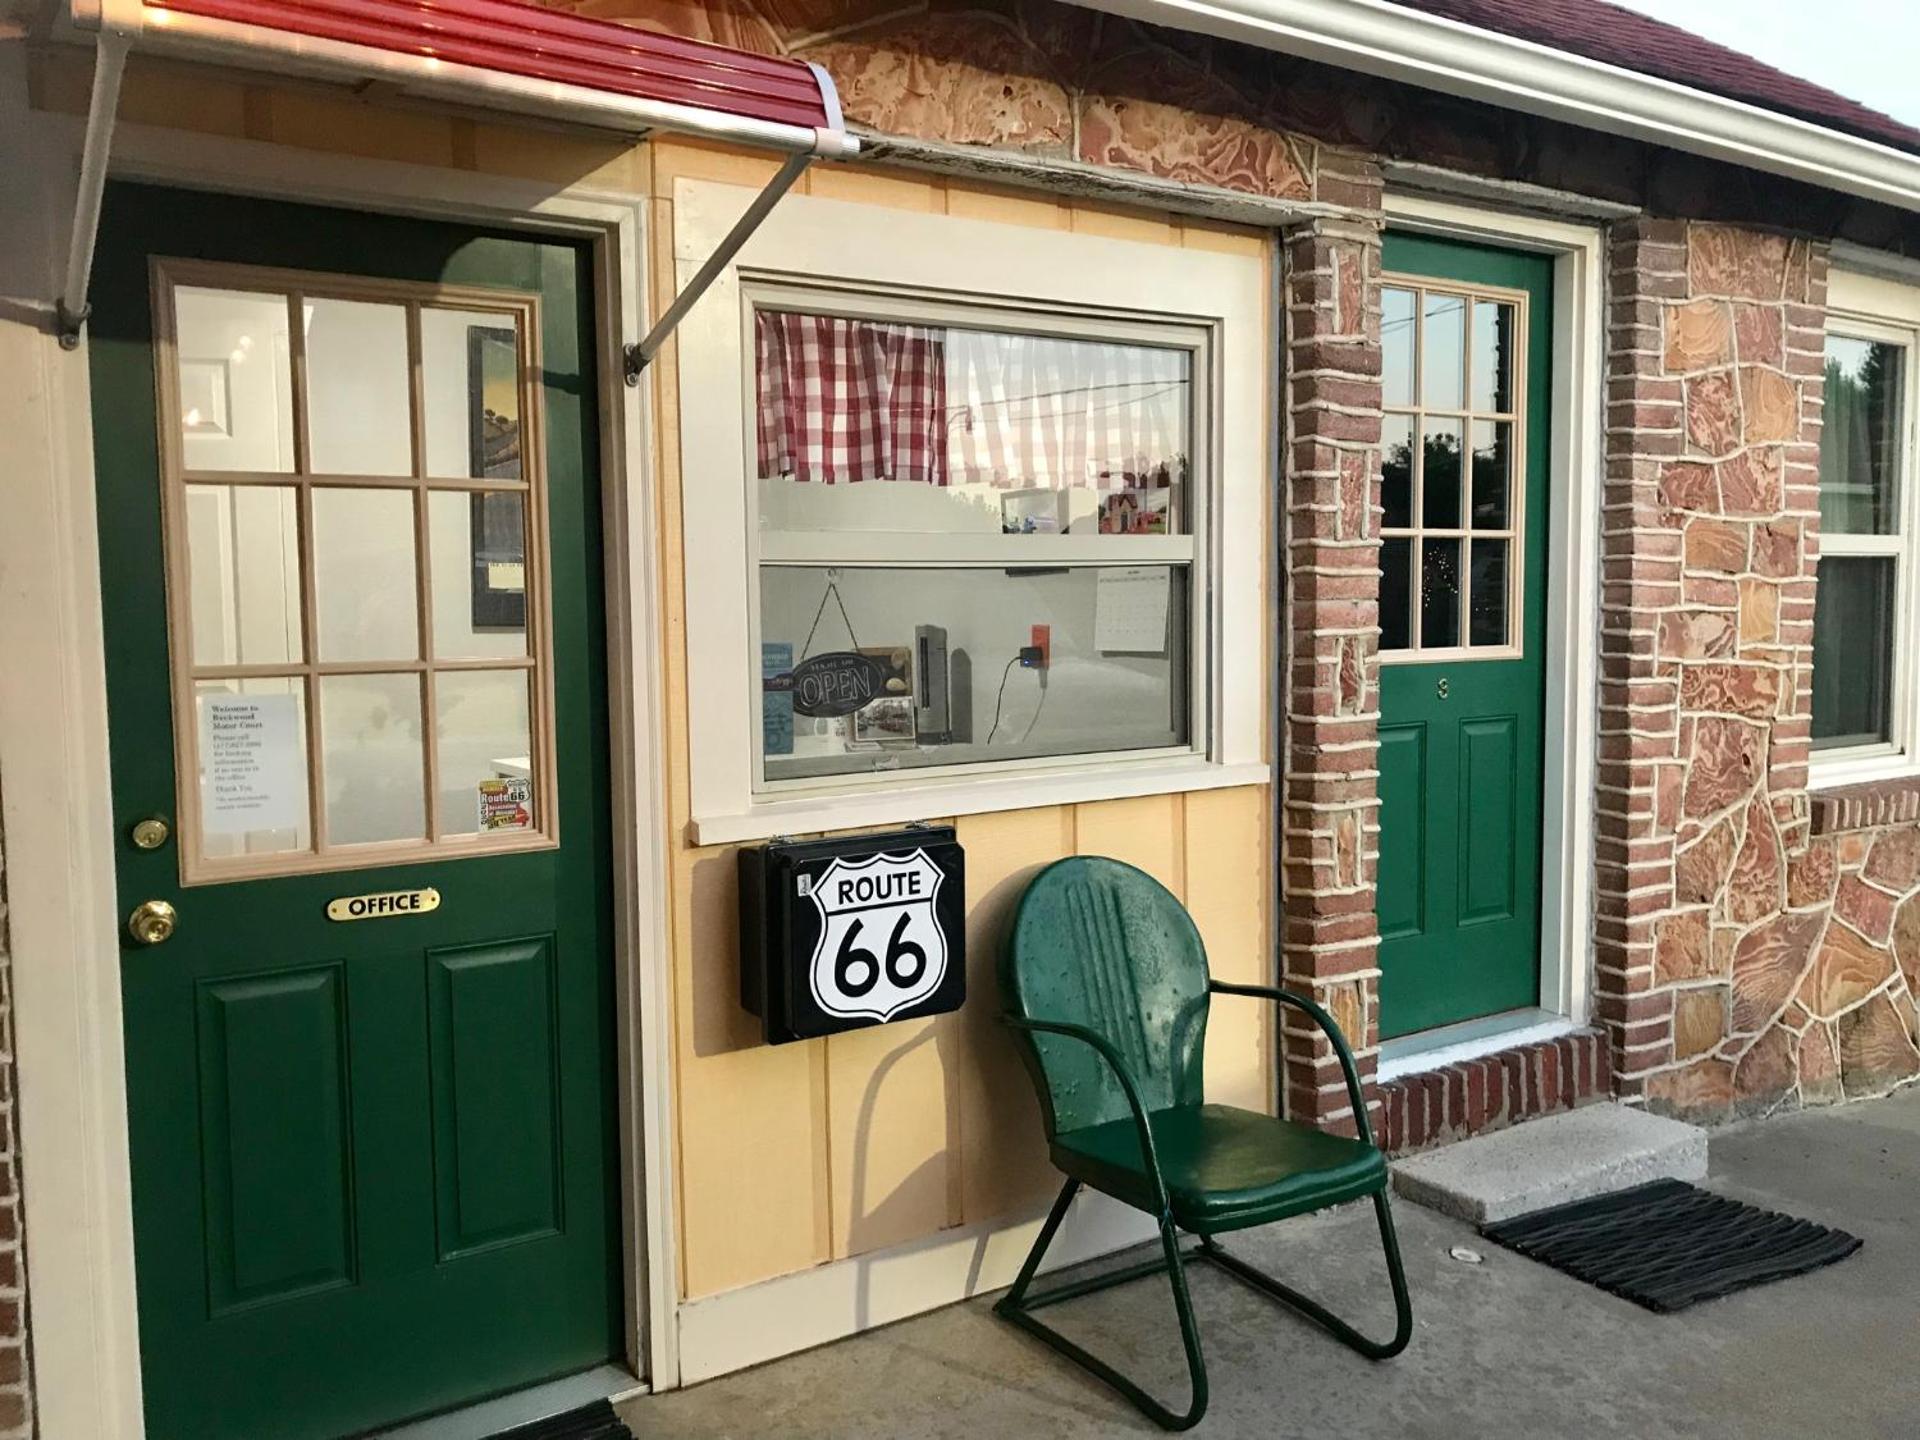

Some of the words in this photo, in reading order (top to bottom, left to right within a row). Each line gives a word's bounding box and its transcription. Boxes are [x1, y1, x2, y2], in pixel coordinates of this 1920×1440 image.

[801, 667, 871, 707] OPEN
[211, 705, 249, 713] Welcome
[480, 792, 509, 804] Route
[510, 791, 525, 801] 66
[838, 871, 921, 905] ROUTE
[349, 894, 420, 915] OFFICE
[834, 911, 927, 998] 66
